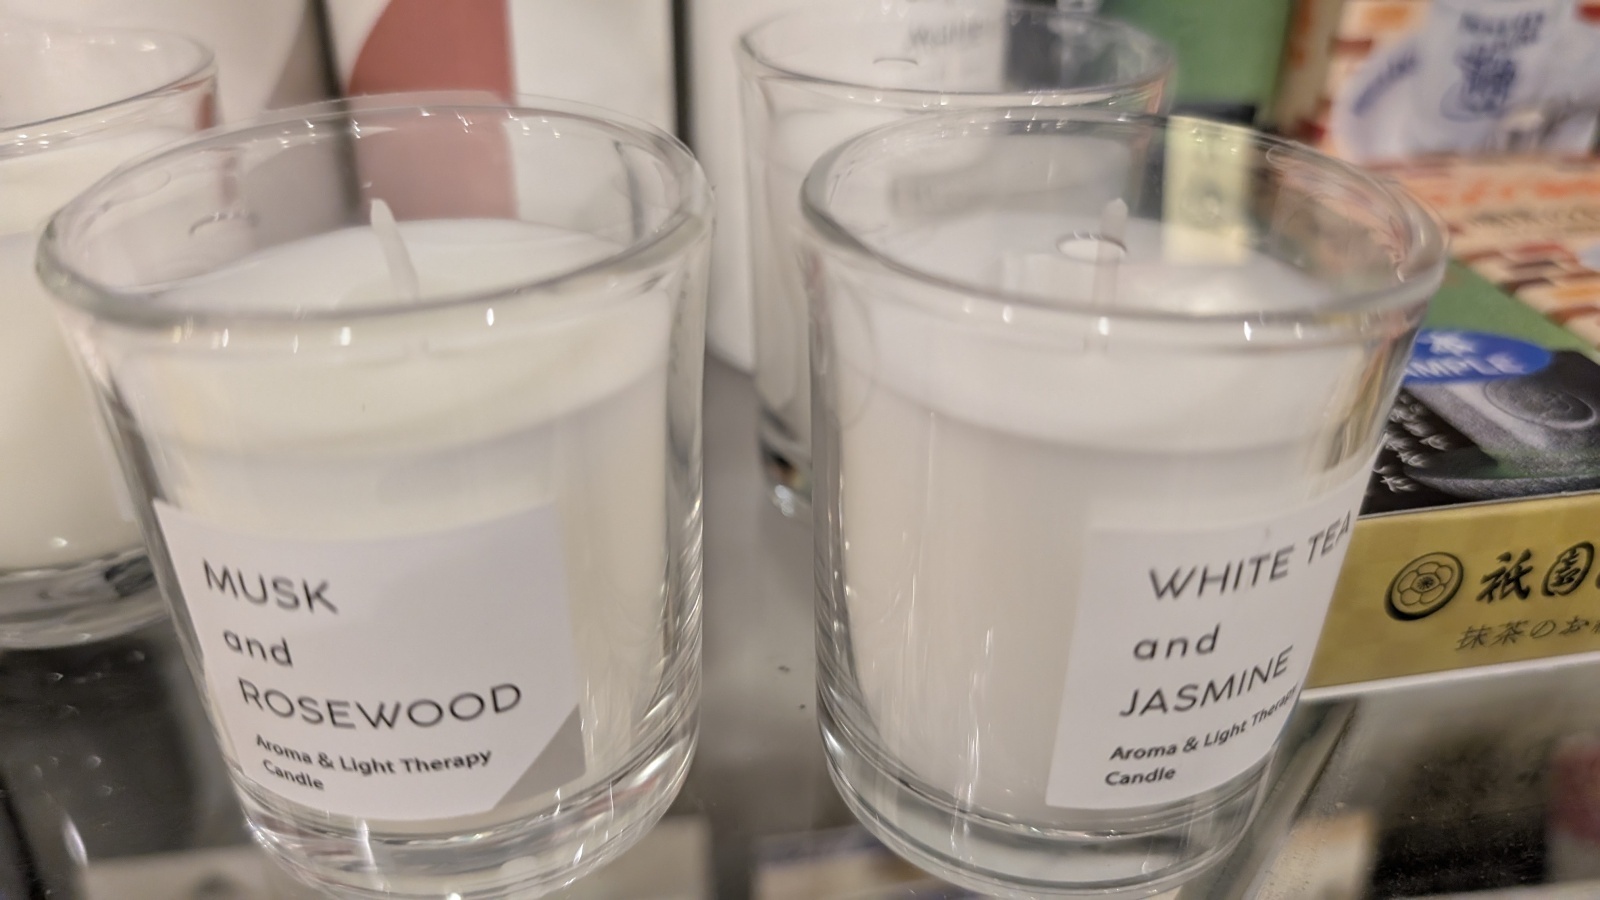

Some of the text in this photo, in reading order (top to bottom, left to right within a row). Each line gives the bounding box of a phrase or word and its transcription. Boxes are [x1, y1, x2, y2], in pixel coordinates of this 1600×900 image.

[1404, 352, 1525, 377] MPLE
[1149, 509, 1351, 600] WHITE TEA
[1476, 541, 1600, 603] 祇園
[202, 558, 339, 614] MUSK
[223, 629, 293, 667] and
[1133, 622, 1220, 661] and
[237, 676, 522, 730] ROSEWOOD
[1119, 644, 1293, 717] JASMINE
[1109, 682, 1298, 761] Aroma & Light Therapy
[256, 734, 492, 776] Aroma & Light Therapy
[262, 759, 325, 791] Candle
[1104, 767, 1176, 786] Candle
